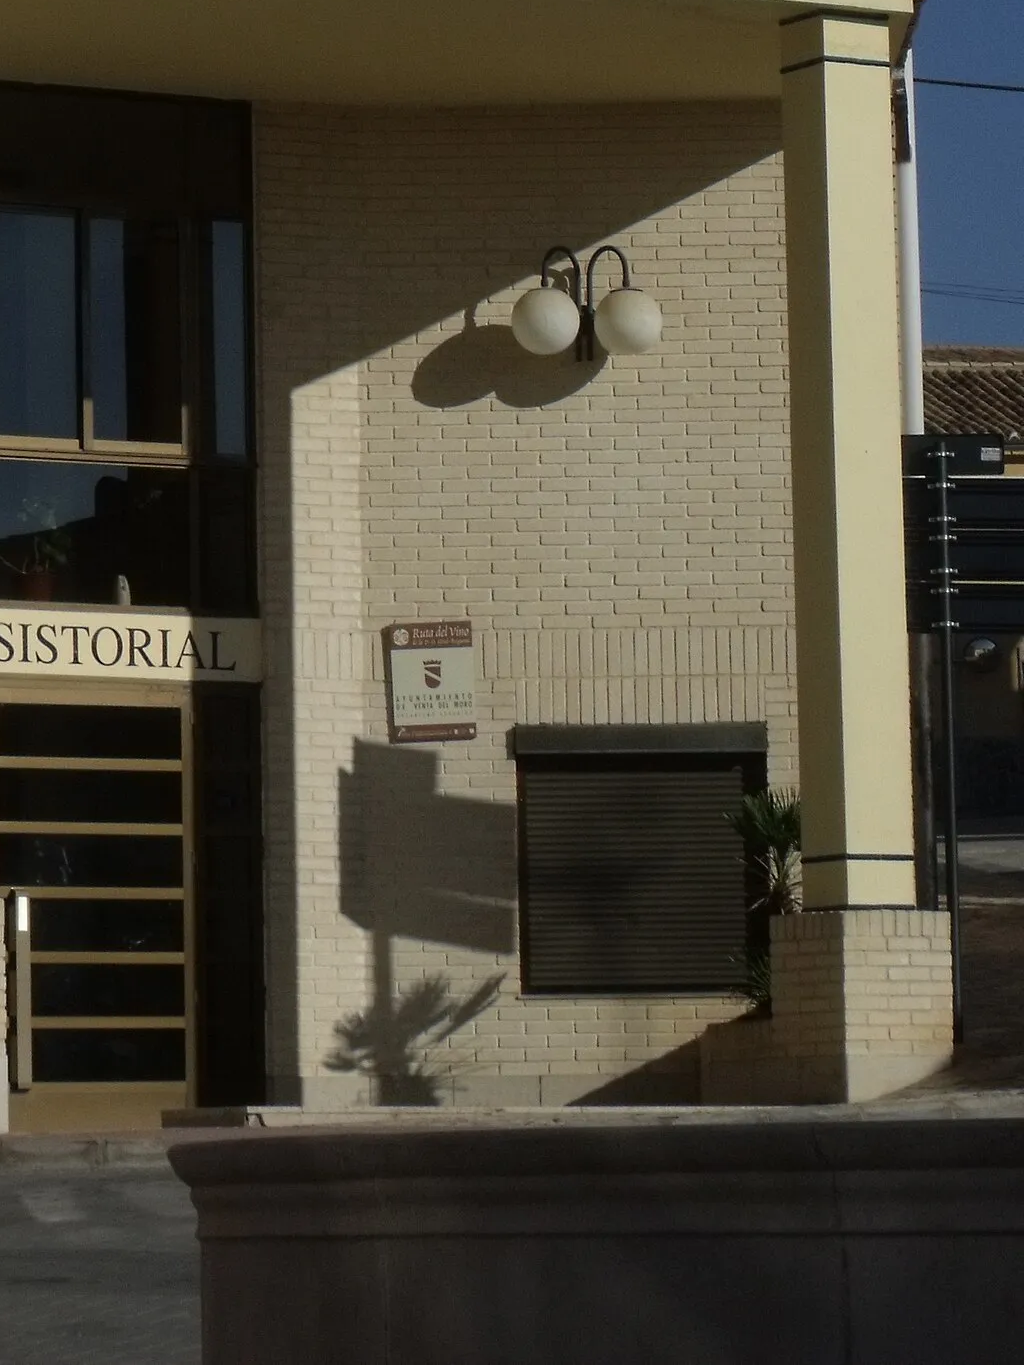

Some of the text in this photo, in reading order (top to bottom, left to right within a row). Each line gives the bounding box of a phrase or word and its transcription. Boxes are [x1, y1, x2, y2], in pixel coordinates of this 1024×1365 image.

[412, 625, 470, 638] Ruta del Vino
